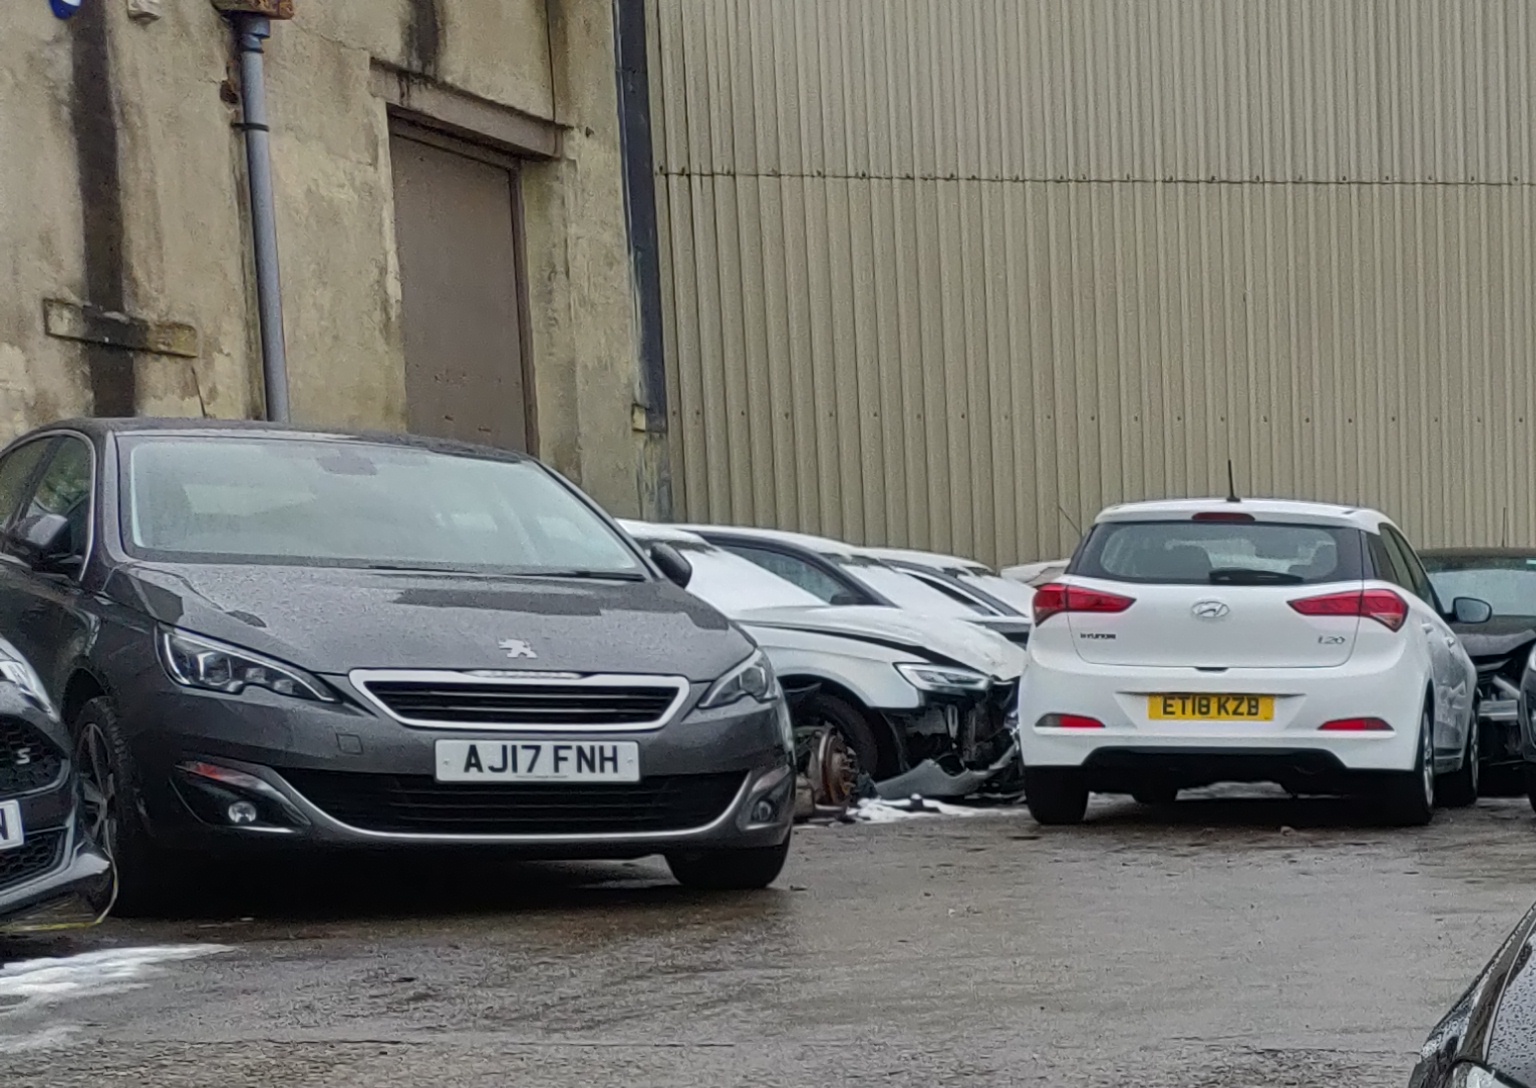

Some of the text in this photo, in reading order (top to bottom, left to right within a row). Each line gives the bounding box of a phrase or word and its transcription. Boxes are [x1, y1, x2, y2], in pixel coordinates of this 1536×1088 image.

[1162, 695, 1260, 716] ET18 KZB
[463, 744, 618, 774] AJ17 FNH
